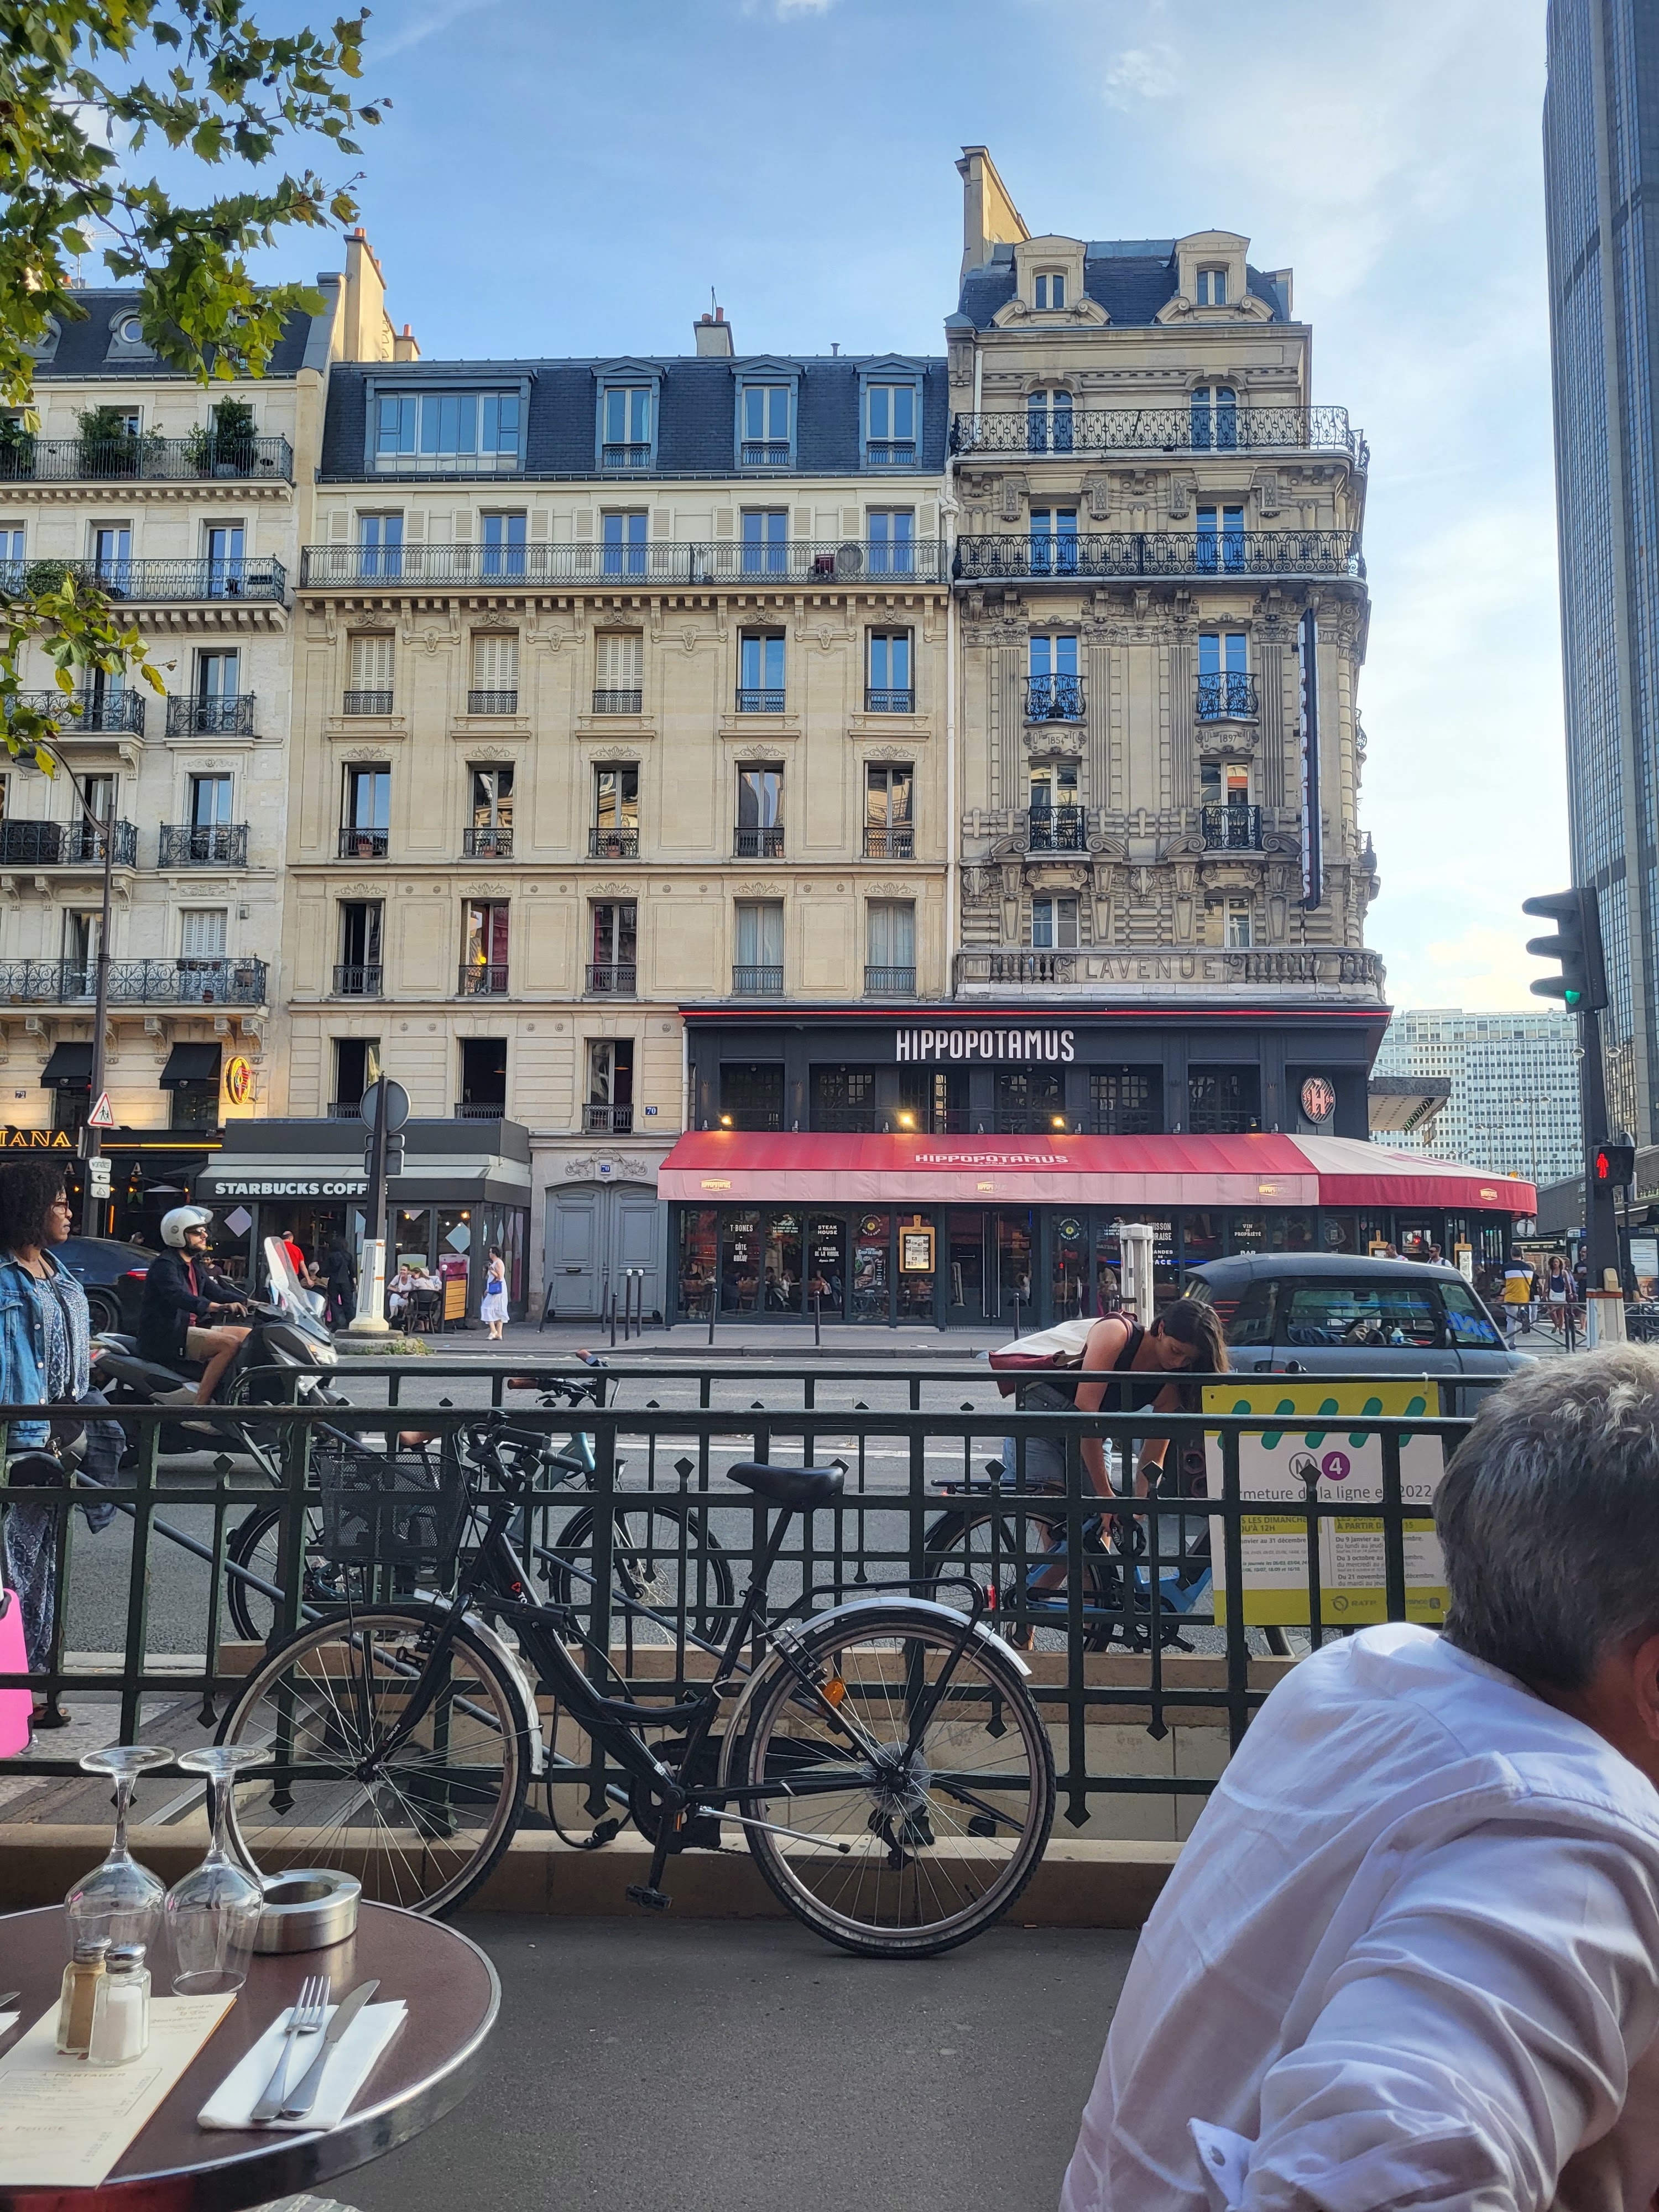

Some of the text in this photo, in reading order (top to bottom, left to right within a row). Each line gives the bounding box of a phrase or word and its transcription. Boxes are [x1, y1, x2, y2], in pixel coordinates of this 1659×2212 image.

[1085, 957, 1215, 979] LAVENUE
[896, 1030, 1074, 1062] HIPPOPOTAMUS
[915, 1154, 1069, 1164] HIPPOPOTAMUS
[215, 1182, 388, 1195] STARBUCKS COFF
[735, 1242, 747, 1250] CÔTE
[1329, 1457, 1342, 1475] 4
[1240, 1489, 1293, 1500] meture
[1320, 1486, 1332, 1499] la
[1337, 1486, 1370, 1501] ligne
[1401, 1485, 1432, 1498] 2022
